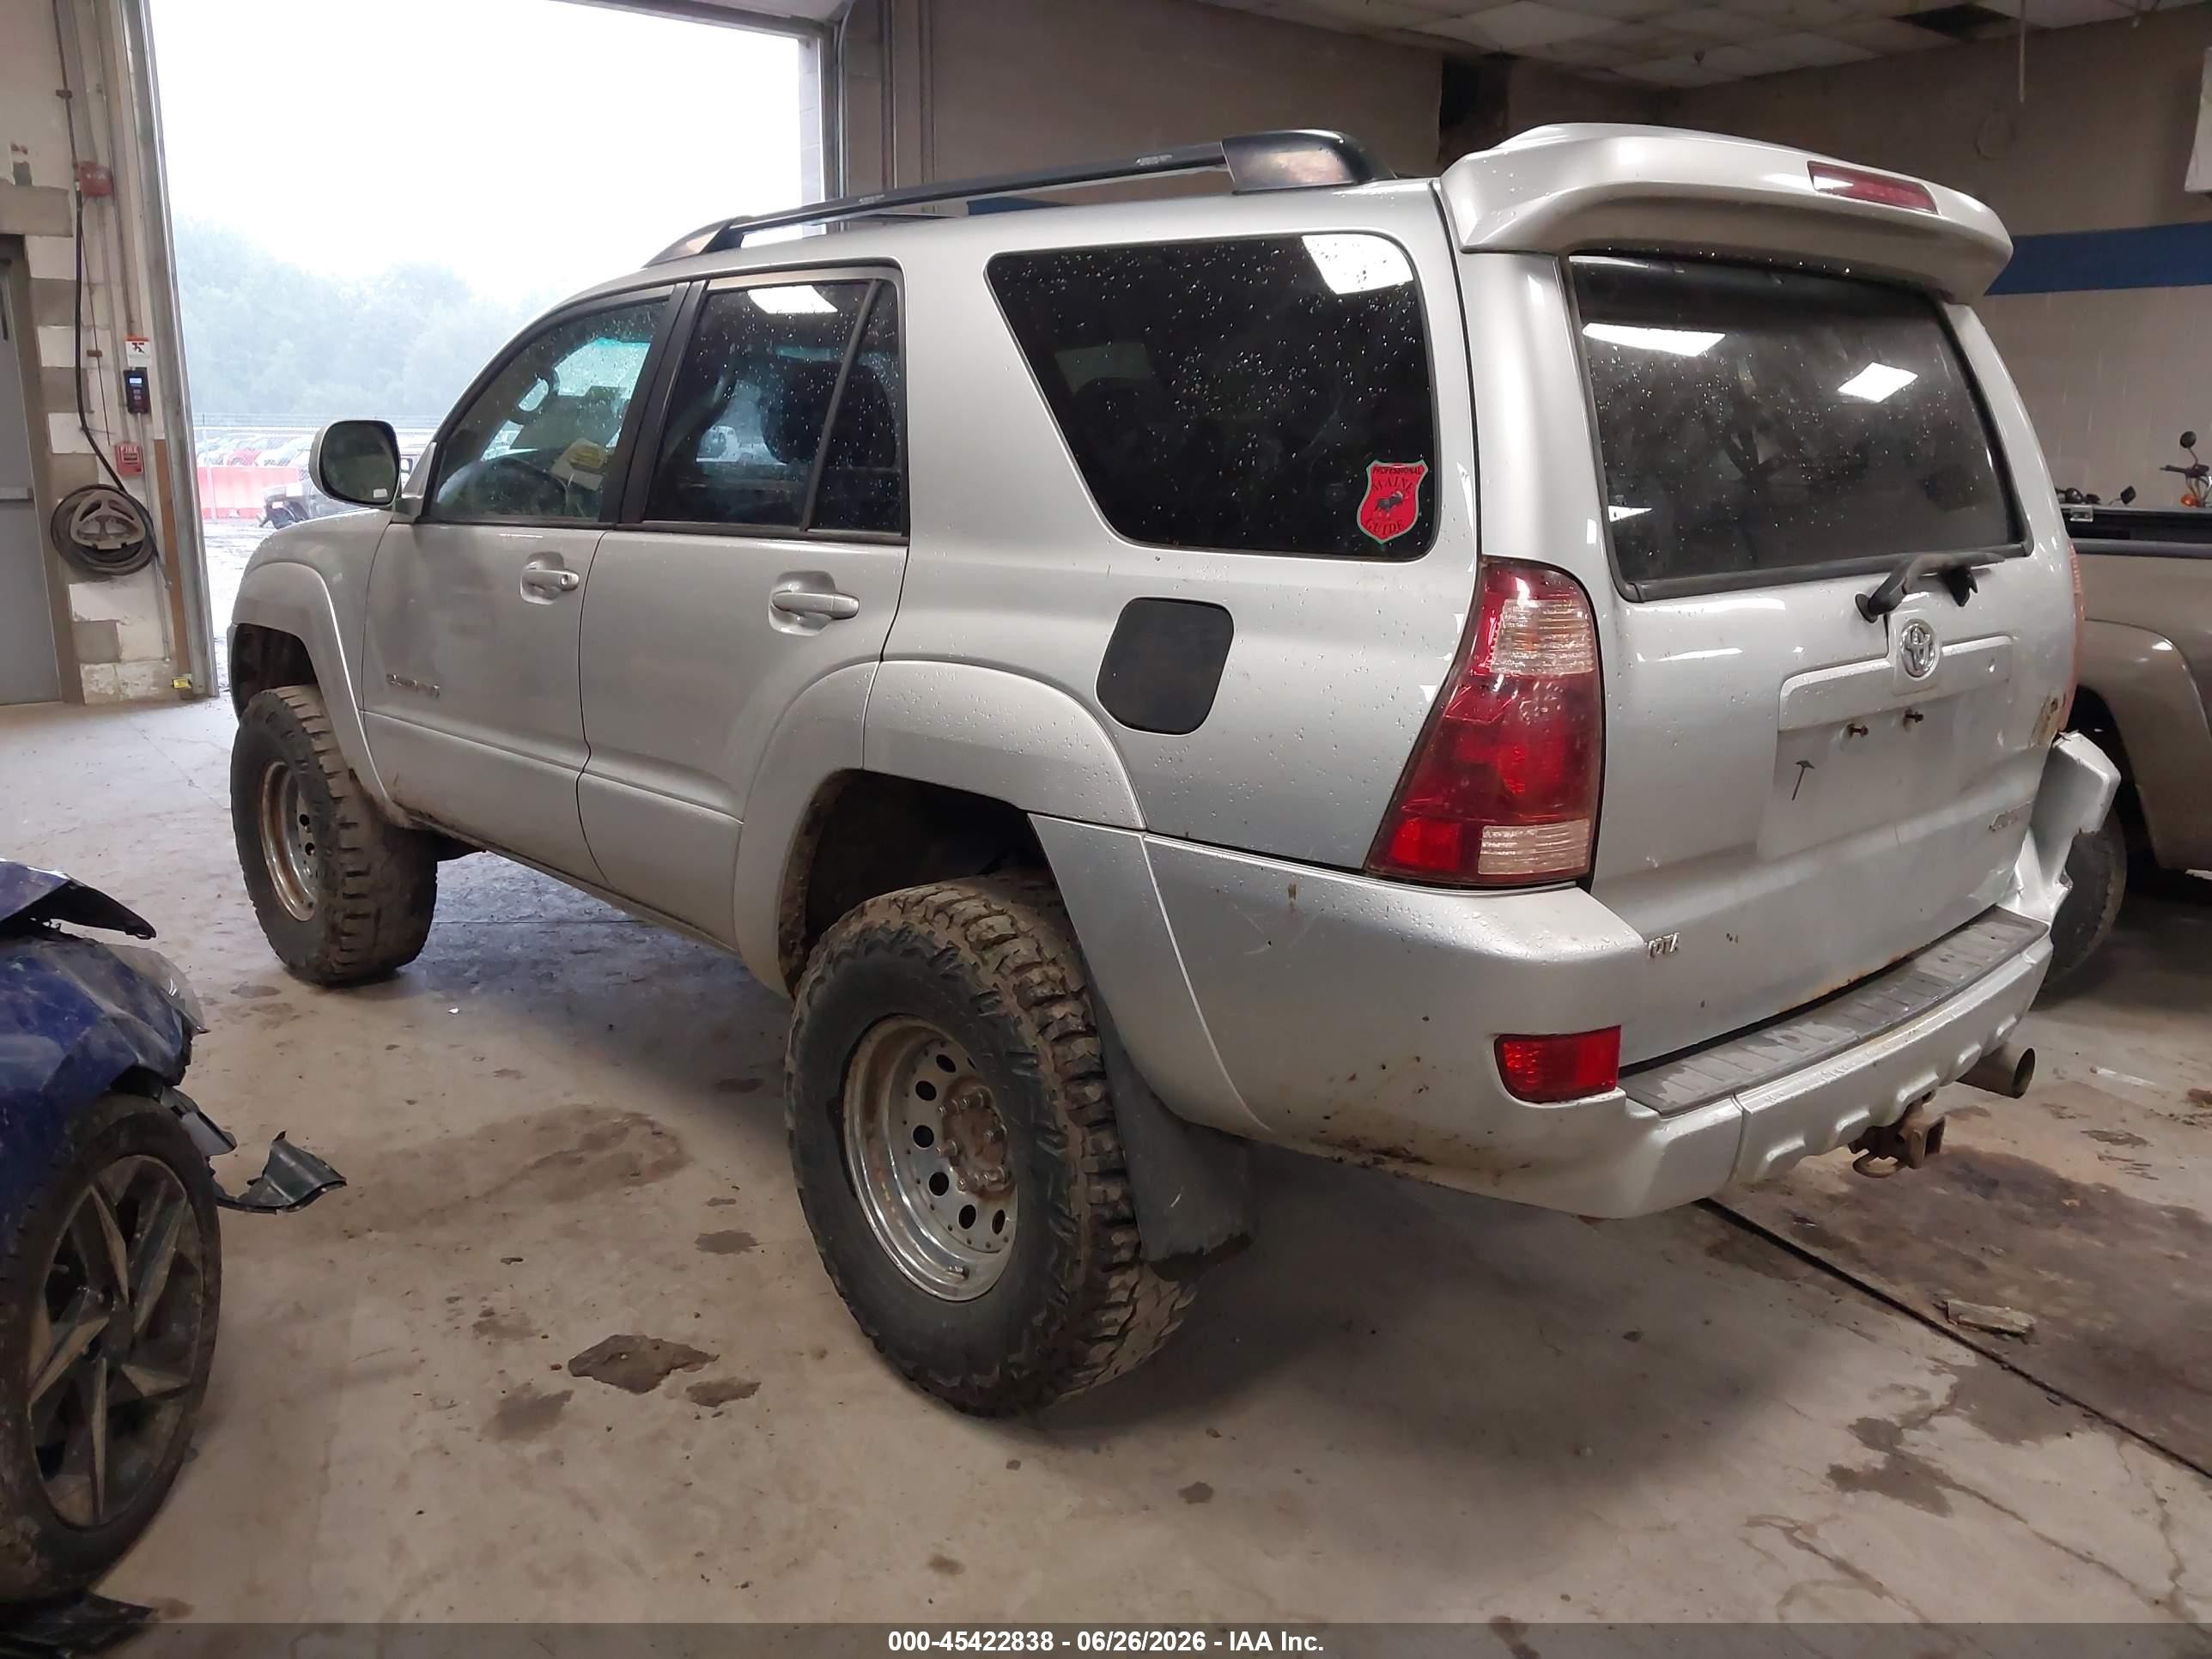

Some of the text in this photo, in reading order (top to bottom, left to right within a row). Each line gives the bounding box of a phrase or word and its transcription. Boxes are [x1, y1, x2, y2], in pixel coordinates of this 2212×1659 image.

[1372, 466, 1422, 475] PROFESSIONAL
[1372, 477, 1413, 492] MAINE
[1365, 518, 1404, 535] GUIDE
